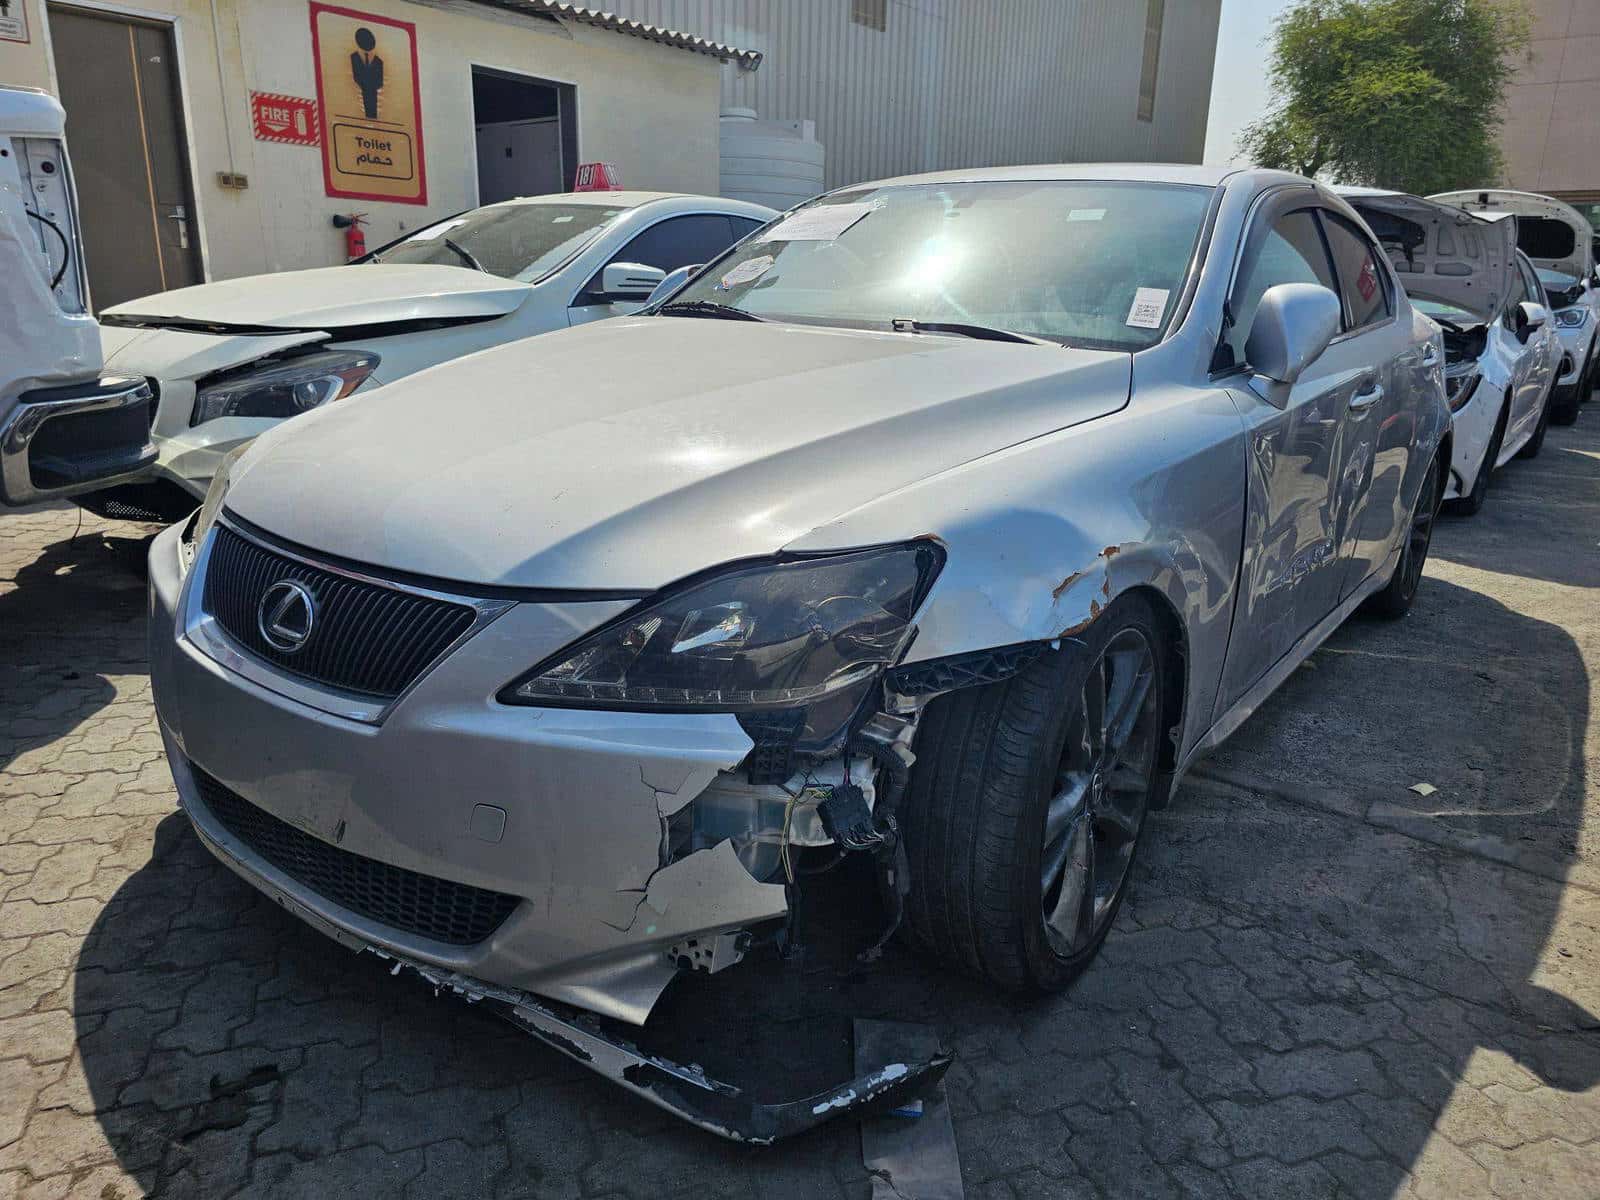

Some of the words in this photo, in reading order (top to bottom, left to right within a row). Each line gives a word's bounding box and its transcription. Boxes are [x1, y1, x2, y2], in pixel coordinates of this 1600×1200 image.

[261, 106, 289, 121] FIRE
[355, 136, 392, 151] Toilet
[356, 153, 393, 166] حمام
